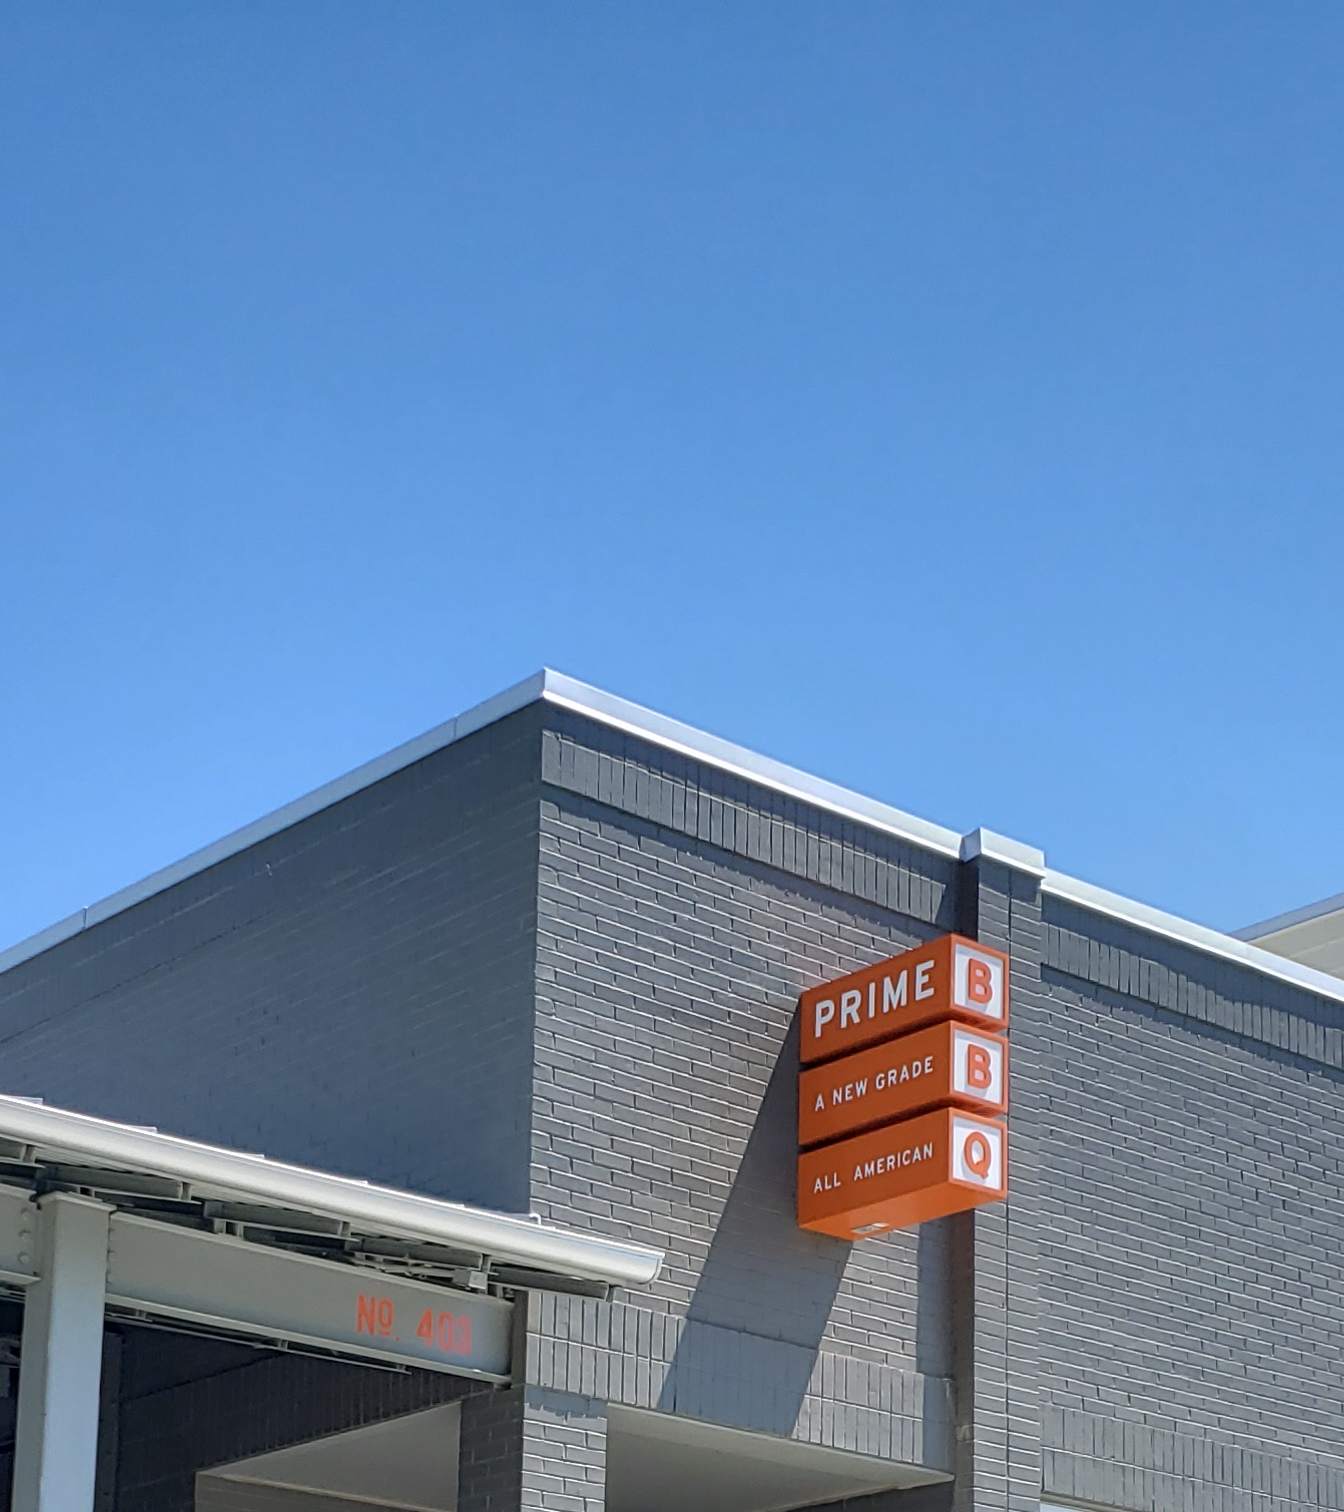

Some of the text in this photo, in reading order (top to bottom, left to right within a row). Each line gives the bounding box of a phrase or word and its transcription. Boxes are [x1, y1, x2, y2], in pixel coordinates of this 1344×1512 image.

[814, 959, 936, 1038] PRIME
[814, 1056, 935, 1112] A NEW GRADE
[813, 1142, 934, 1194] ALL AMERICAN
[416, 1308, 473, 1356] 403
